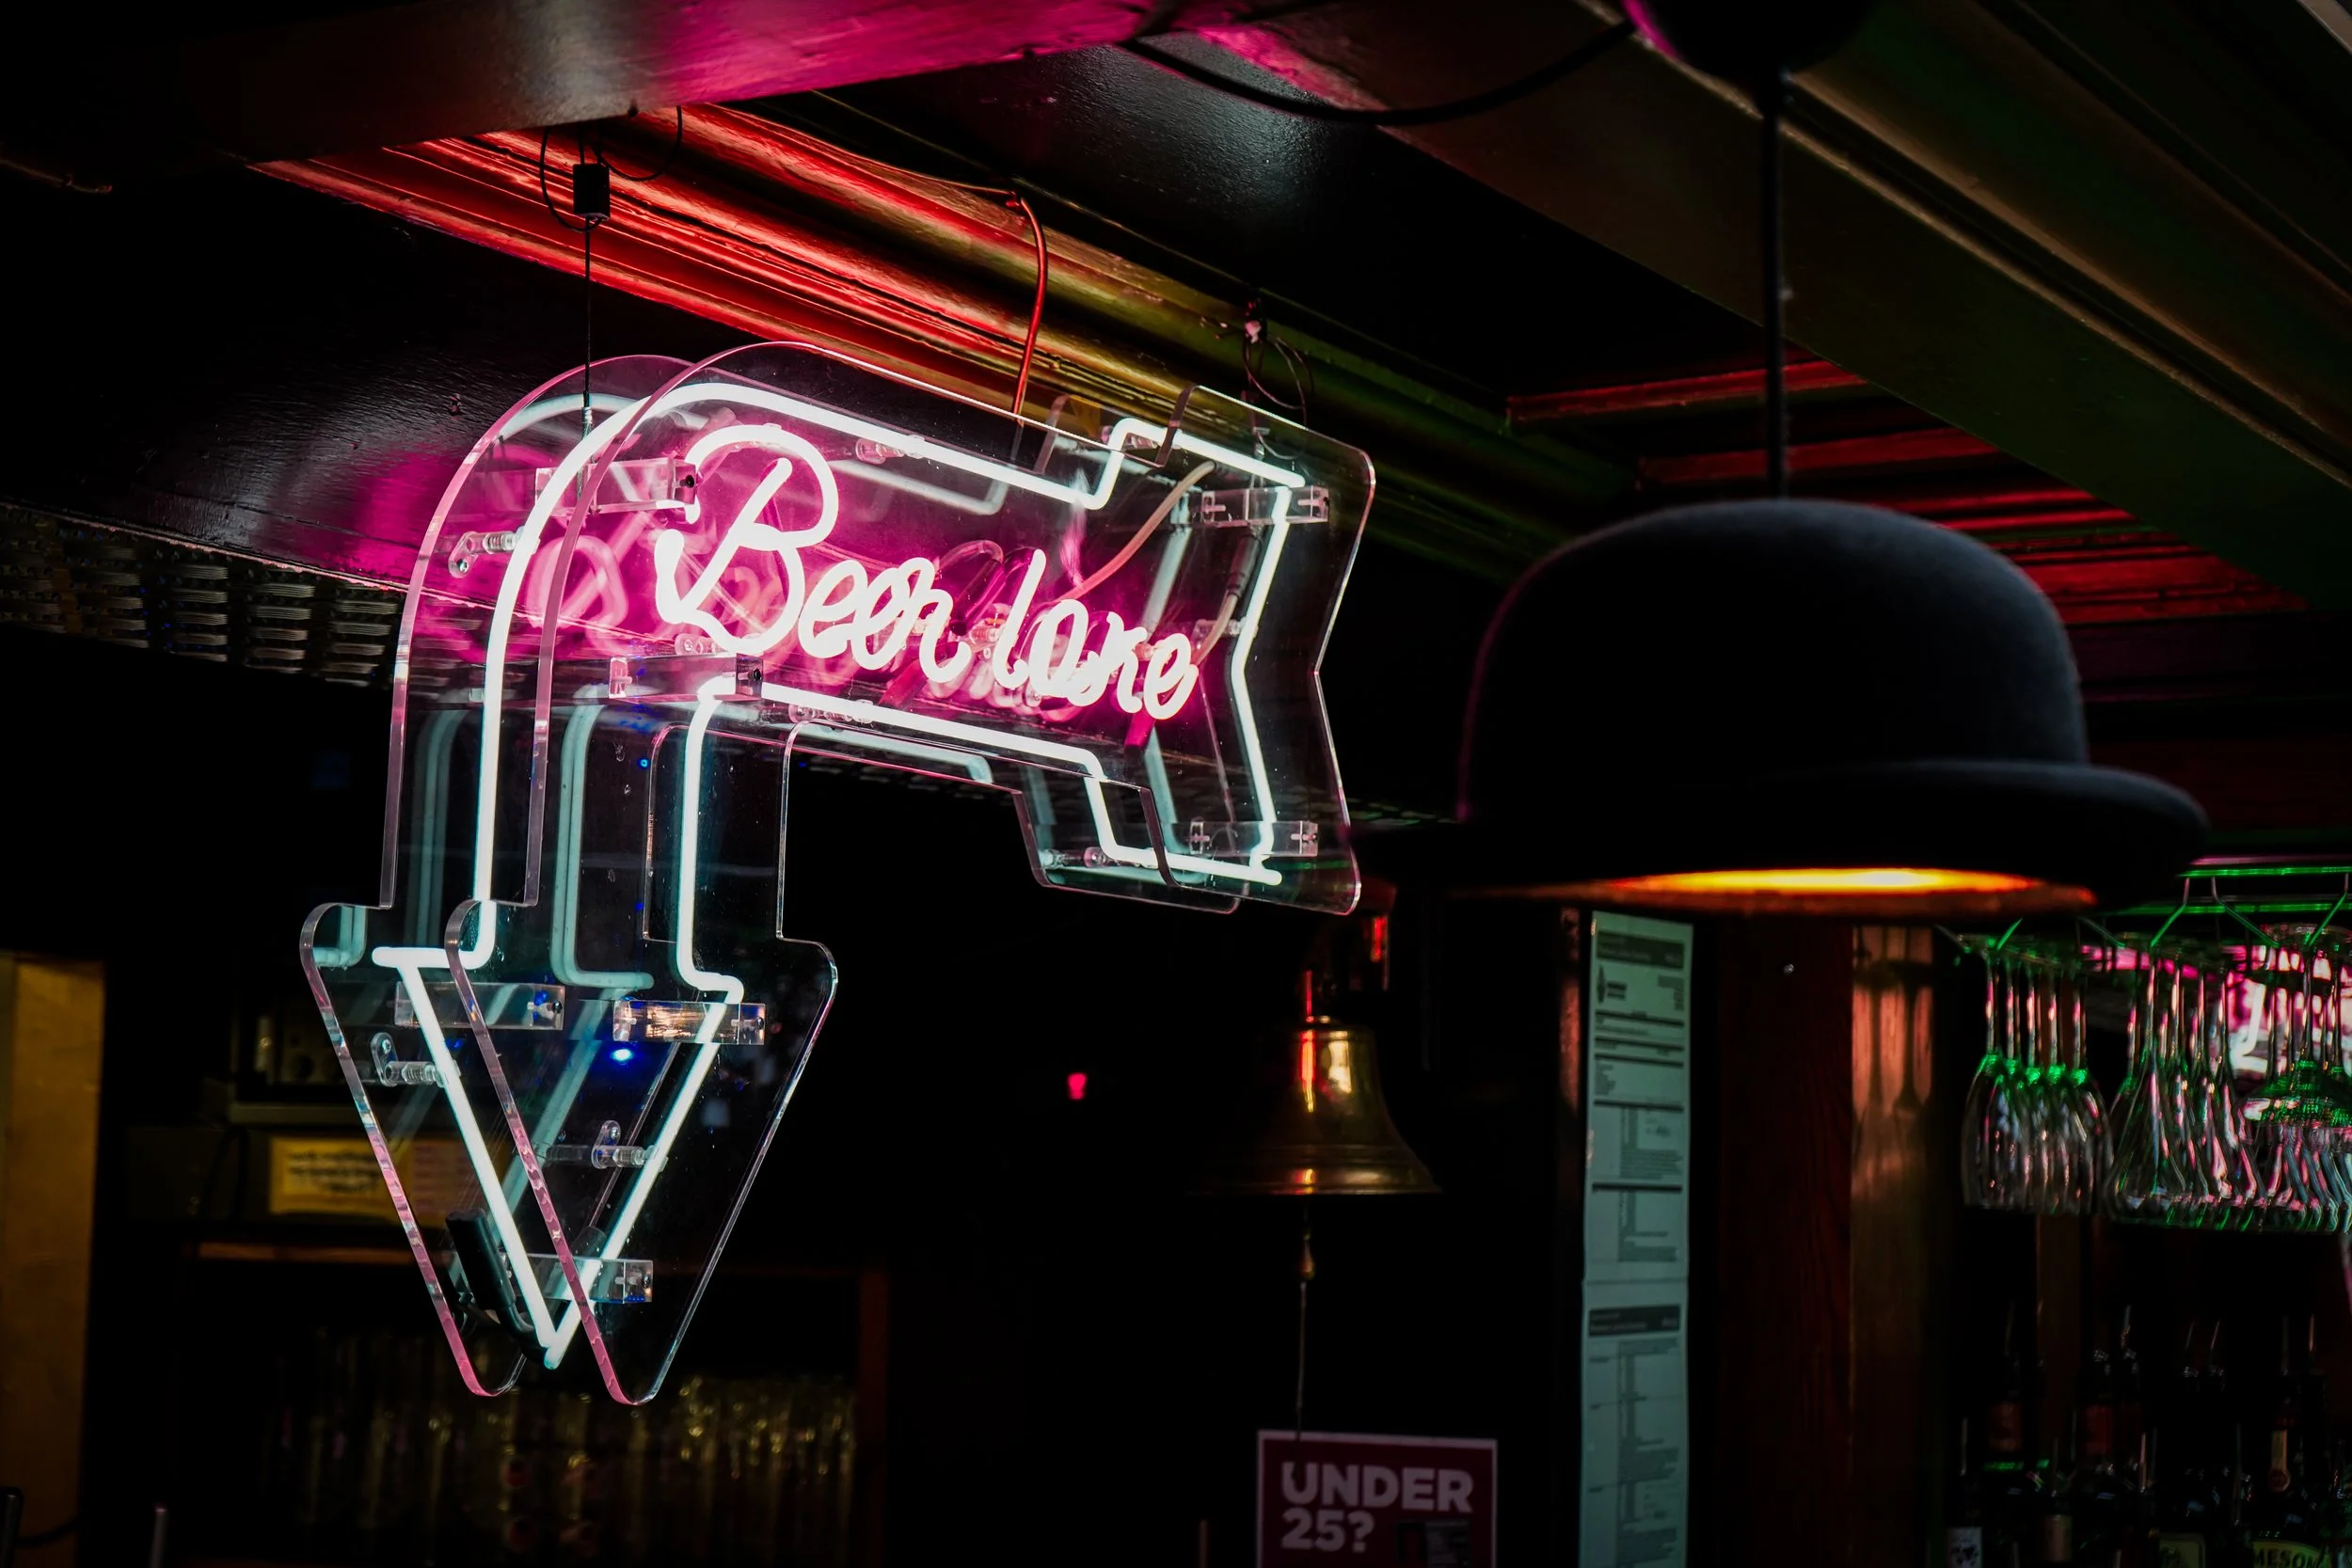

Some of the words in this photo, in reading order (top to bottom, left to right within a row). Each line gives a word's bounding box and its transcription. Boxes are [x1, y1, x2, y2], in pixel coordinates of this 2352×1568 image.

[654, 424, 972, 683] Beer
[1280, 1461, 1474, 1513] UNDER
[1280, 1506, 1375, 1554] 25?
